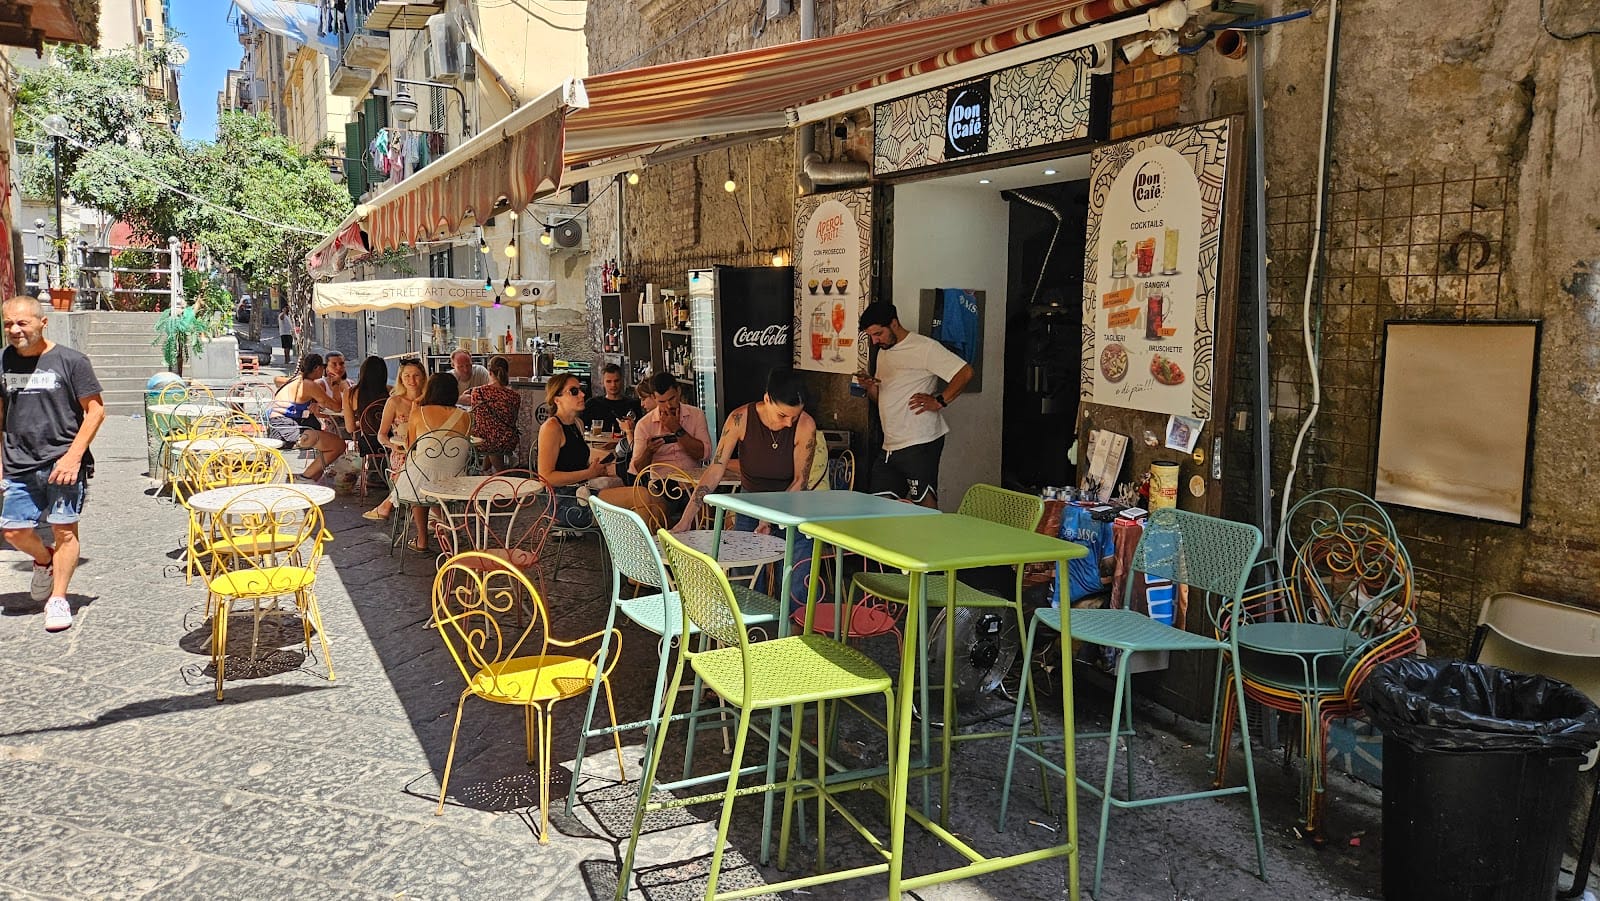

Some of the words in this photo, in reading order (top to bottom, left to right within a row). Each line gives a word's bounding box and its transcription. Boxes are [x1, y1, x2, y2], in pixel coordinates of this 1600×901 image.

[954, 104, 981, 122] Don
[953, 118, 982, 139] Café
[1138, 173, 1161, 186] Don
[1136, 184, 1161, 201] Café
[816, 214, 844, 238] APEROL
[1130, 219, 1164, 230] COCKTAILS
[822, 247, 846, 255] PROSECCO
[1144, 281, 1170, 289] SANGRIA
[382, 288, 422, 298] STREET
[424, 287, 445, 296] ART
[448, 288, 488, 298] COFFEE
[733, 324, 790, 347] Coca-Cola
[1104, 334, 1126, 342] TAGLIERI
[1148, 345, 1183, 353] BRUSCHETTE
[1077, 529, 1098, 543] MSC
